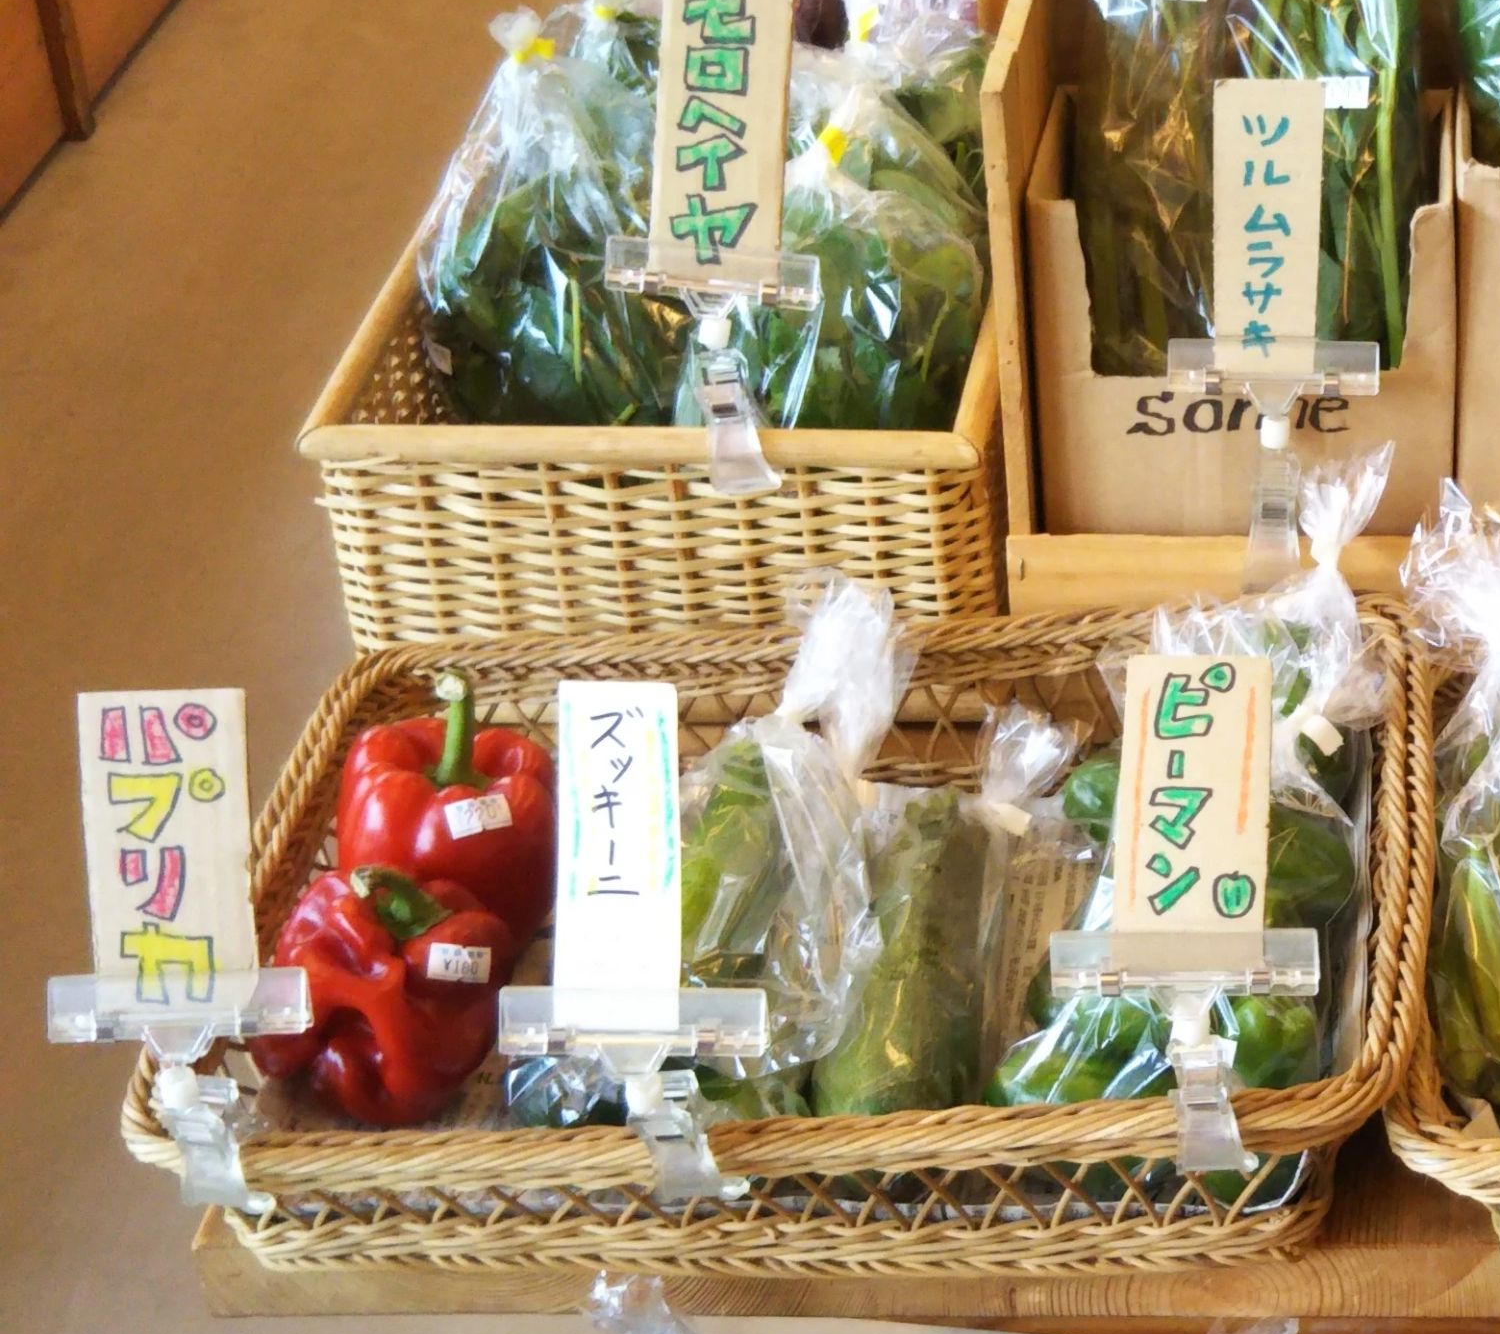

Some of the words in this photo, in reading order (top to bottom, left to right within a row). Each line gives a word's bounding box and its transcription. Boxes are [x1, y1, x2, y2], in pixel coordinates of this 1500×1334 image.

[1242, 114, 1292, 358] ツルムラサキ
[98, 702, 227, 1006] パプリカ
[587, 706, 644, 897] ズッキーニ
[1145, 661, 1237, 917] ピーマン
